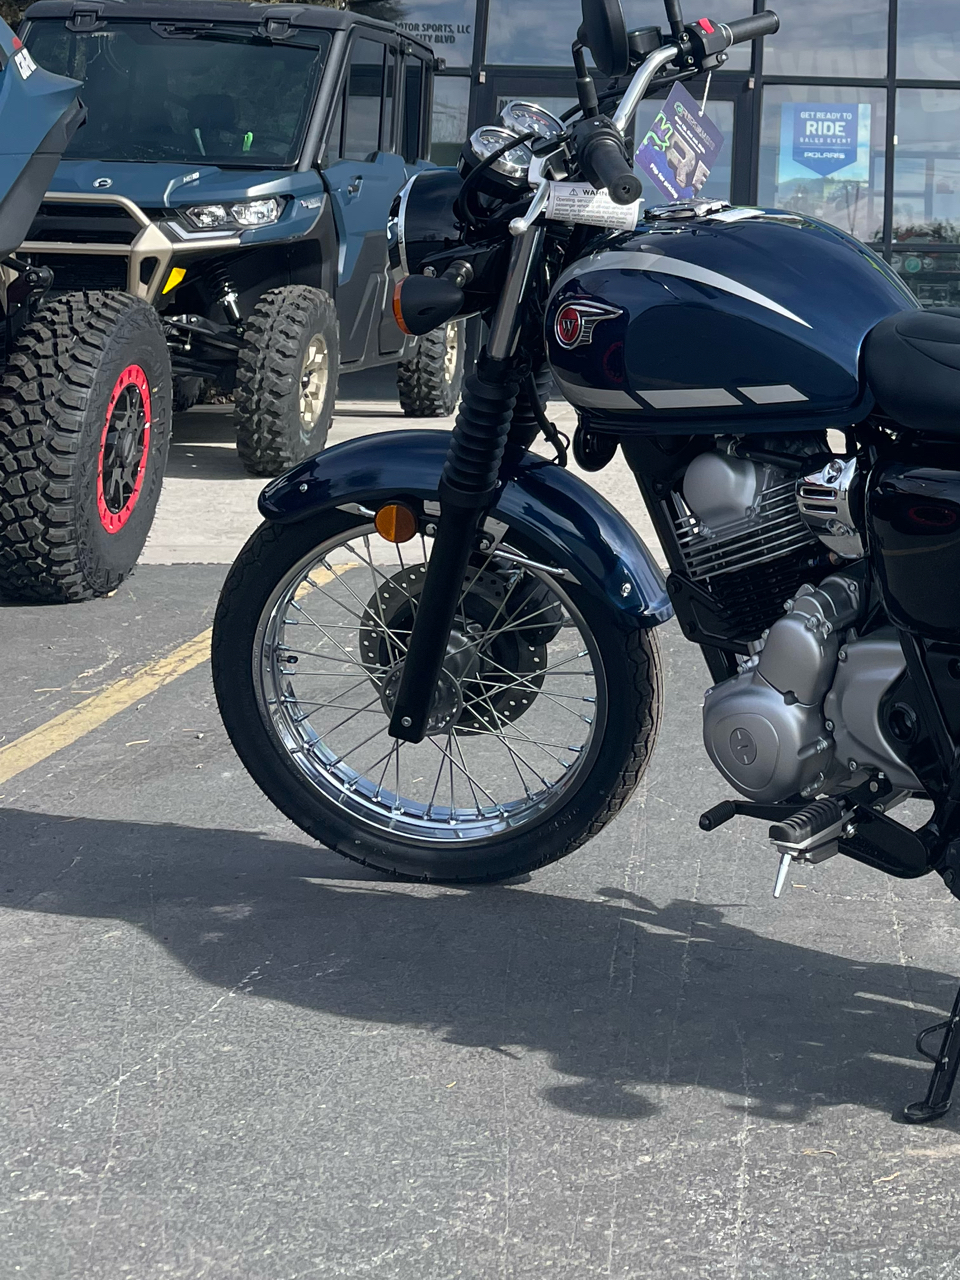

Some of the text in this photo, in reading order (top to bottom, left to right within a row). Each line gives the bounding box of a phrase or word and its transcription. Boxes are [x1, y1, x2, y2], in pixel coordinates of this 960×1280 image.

[395, 22, 471, 34] OTOR SPORTS, LLC
[434, 35, 456, 44] BLVD
[800, 111, 853, 120] GET READY TO
[805, 120, 846, 136] RIDE
[799, 136, 824, 144] SALES
[803, 151, 846, 159] POLARIS
[561, 319, 575, 336] W
